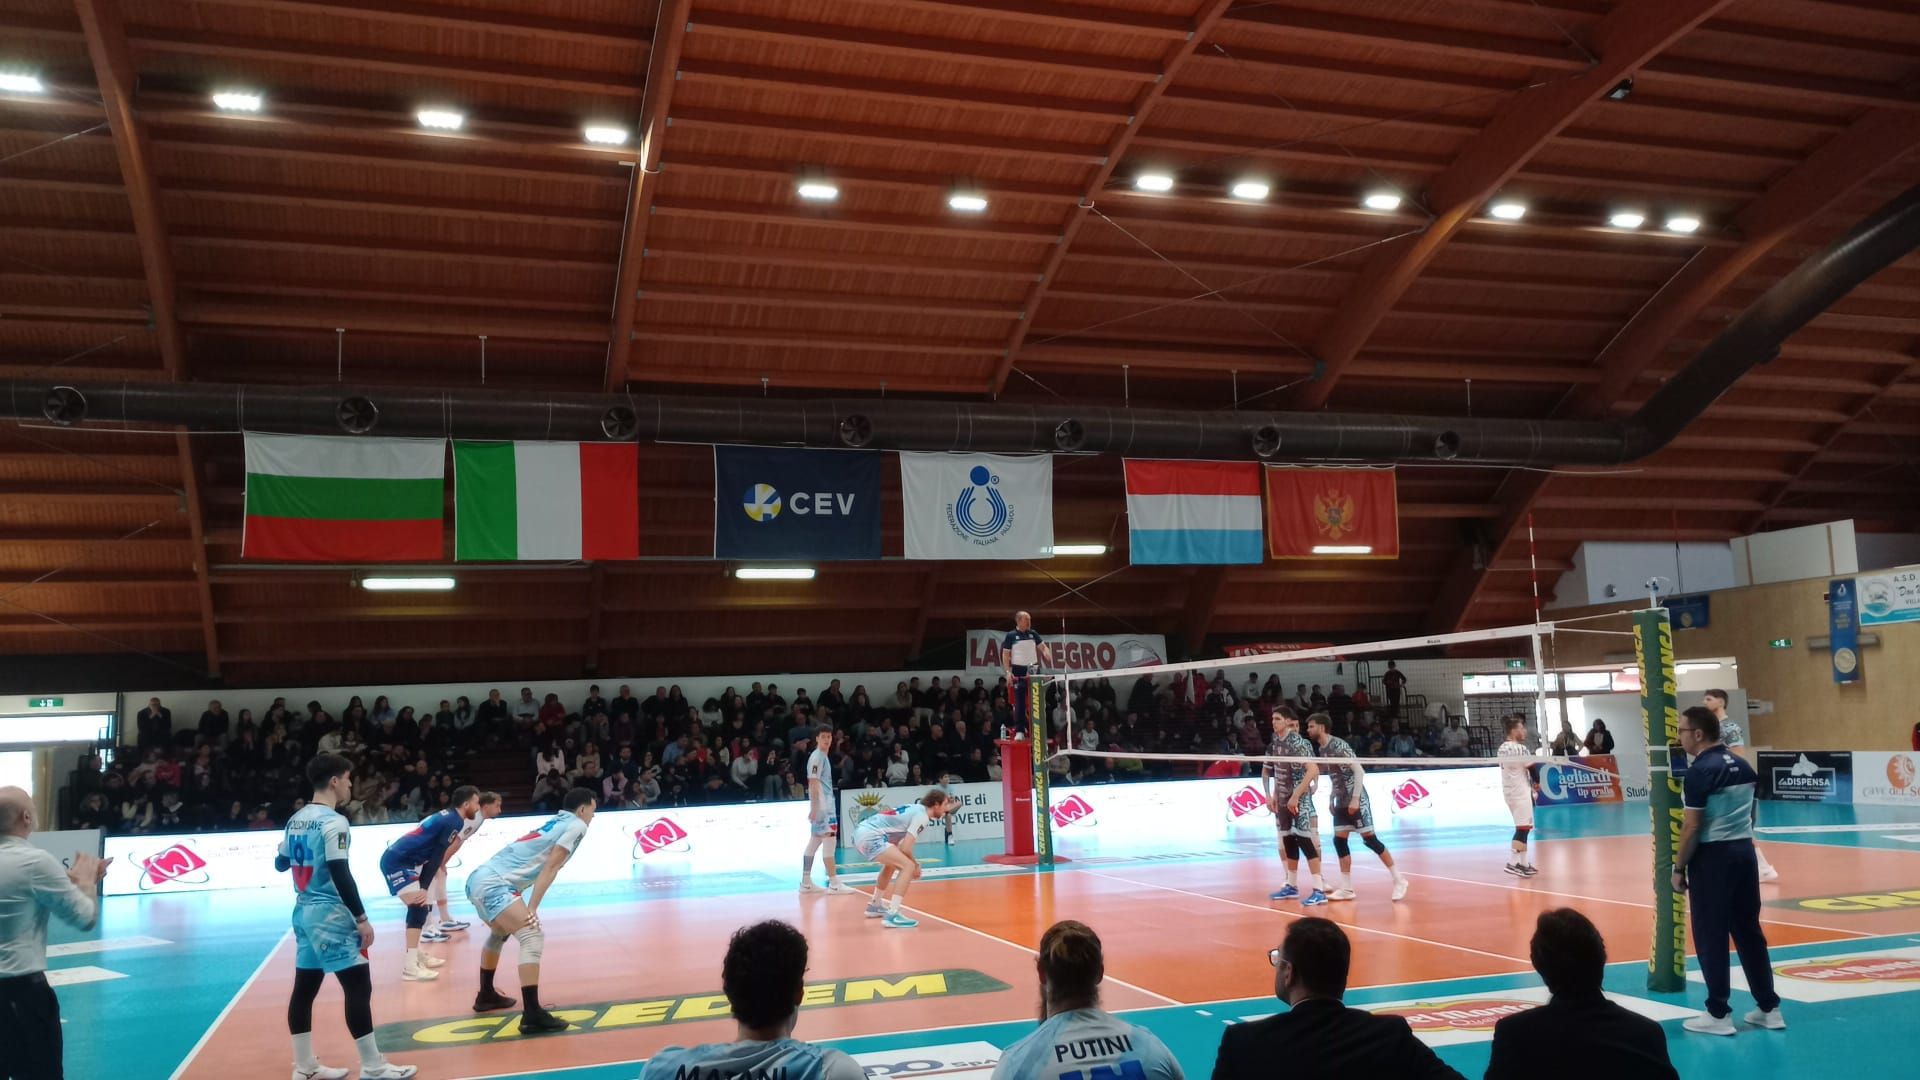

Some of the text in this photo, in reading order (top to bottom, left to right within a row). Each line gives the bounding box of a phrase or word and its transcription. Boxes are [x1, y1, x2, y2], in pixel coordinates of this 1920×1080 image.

[789, 492, 855, 515] CEV
[946, 503, 1015, 545] FEDERAZIONE ITALIANA PALLAVOLO
[969, 638, 1116, 670] LANEGRO
[1658, 623, 1677, 696] BANCA
[1032, 682, 1042, 765] CREDEM BANCA
[1626, 786, 1648, 798] Studi
[1787, 777, 1831, 786] DISPENSA
[974, 793, 987, 805] di
[1036, 772, 1046, 855] CREDEM BANCA
[1407, 1011, 1443, 1024] el
[1054, 1034, 1134, 1063] PUTINI
